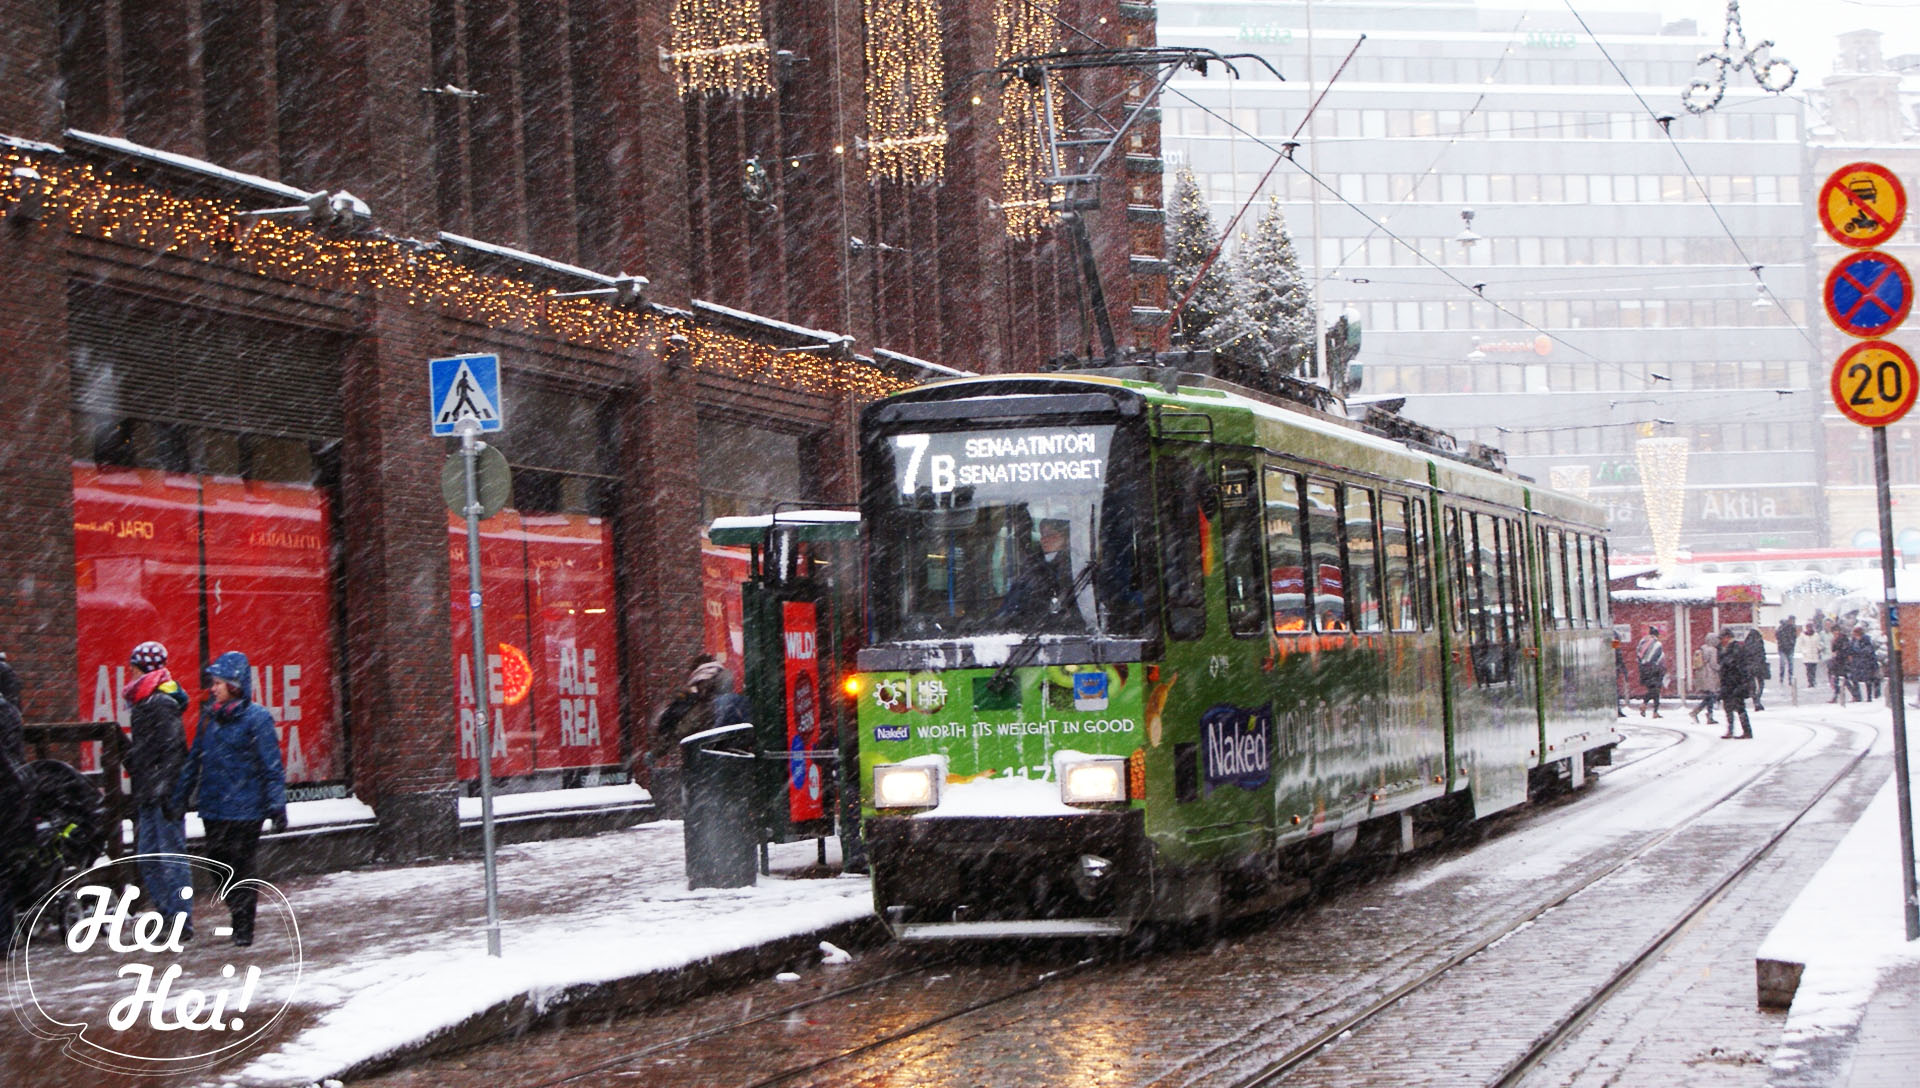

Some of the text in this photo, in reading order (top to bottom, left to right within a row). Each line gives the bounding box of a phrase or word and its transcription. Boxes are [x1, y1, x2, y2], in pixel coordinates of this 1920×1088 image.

[1848, 361, 1902, 405] 20
[965, 433, 1095, 458] SENAATINTORI
[959, 459, 1102, 484] SENATSTORGET
[1702, 491, 1776, 520] Aktia
[785, 632, 816, 660] WILD!
[559, 648, 598, 696] ALE
[93, 665, 132, 723] AL
[918, 681, 948, 693] HSL
[918, 693, 948, 705] HRT
[561, 699, 600, 747] REA
[877, 727, 908, 739] Naked
[917, 718, 1134, 738] WORTH ITS WEIGHT IN GOOD
[1207, 717, 1270, 778] Naked
